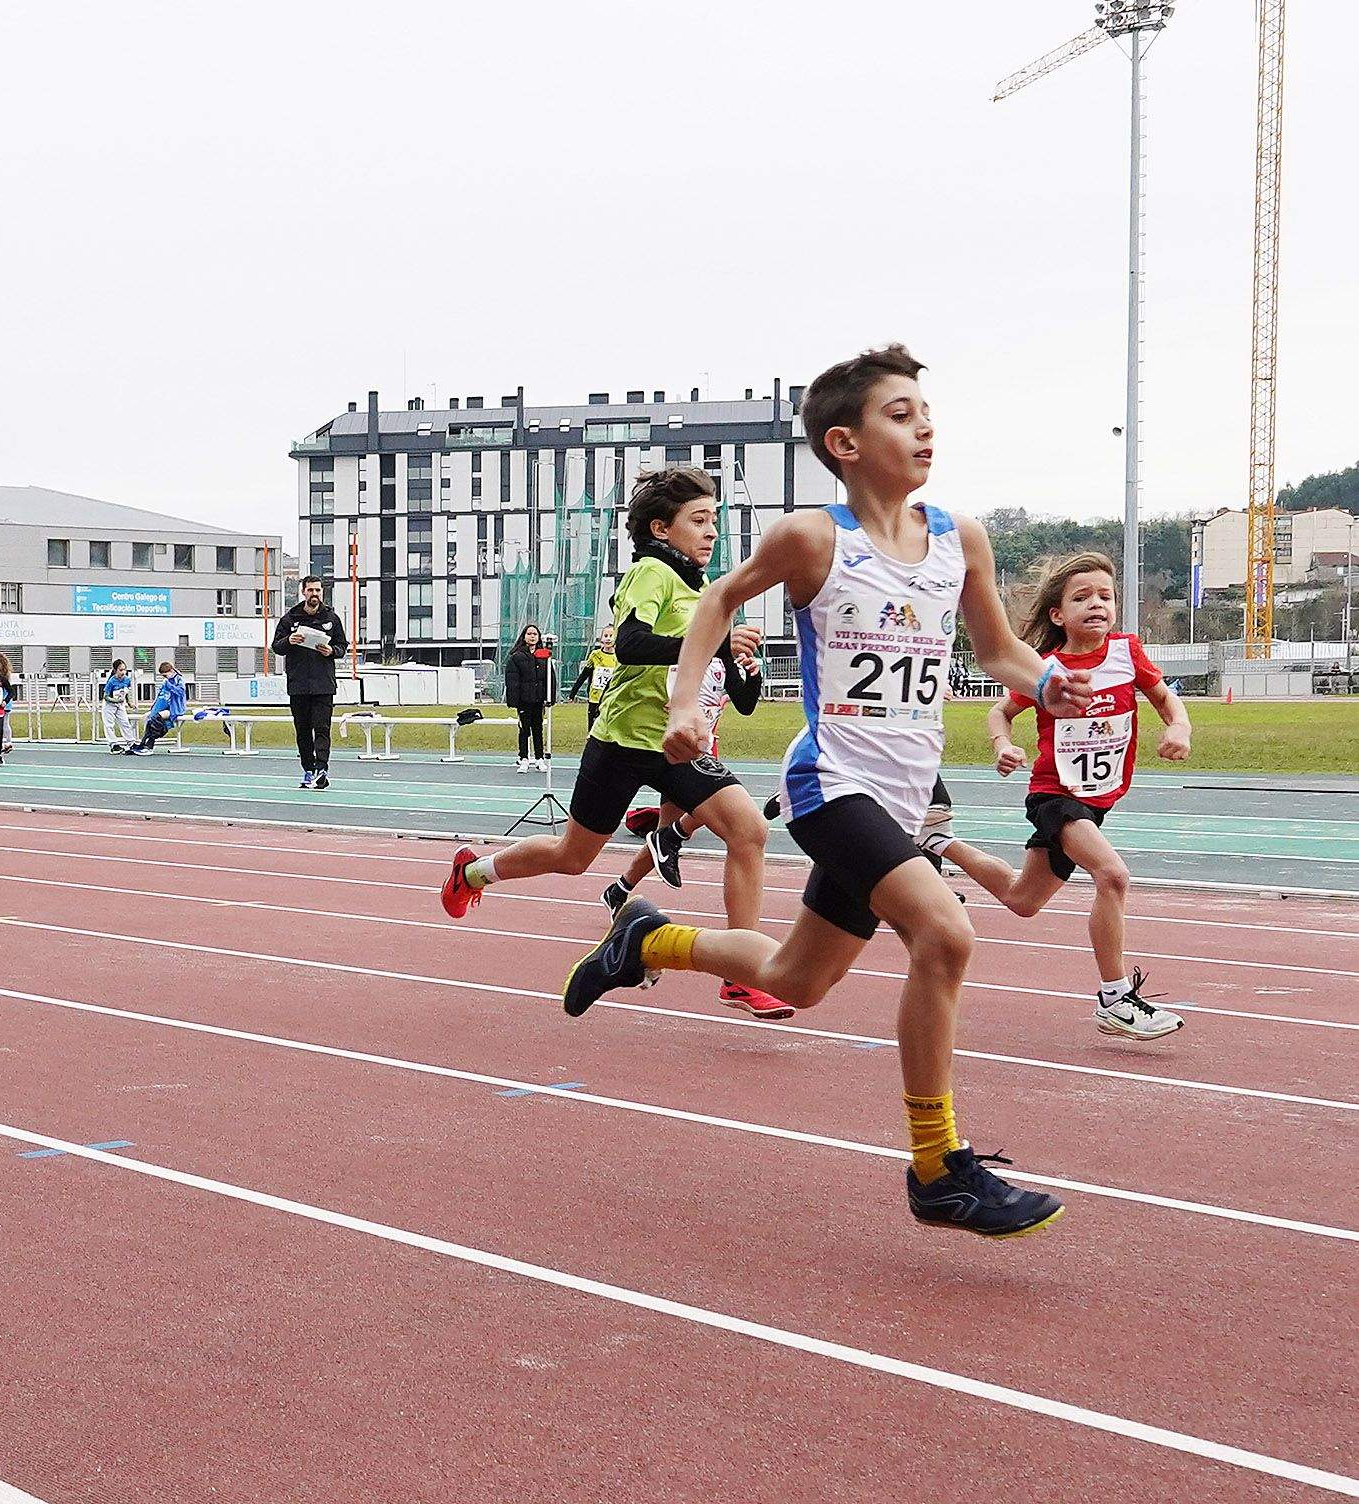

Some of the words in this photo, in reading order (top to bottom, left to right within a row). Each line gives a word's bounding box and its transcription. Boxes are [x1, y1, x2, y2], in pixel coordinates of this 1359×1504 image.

[111, 592, 135, 601] Centro
[5, 630, 35, 638] GALICIA
[828, 641, 859, 650] GRAN
[860, 643, 901, 653] PREMIO
[846, 652, 941, 705] 215
[1071, 747, 1125, 782] 157
